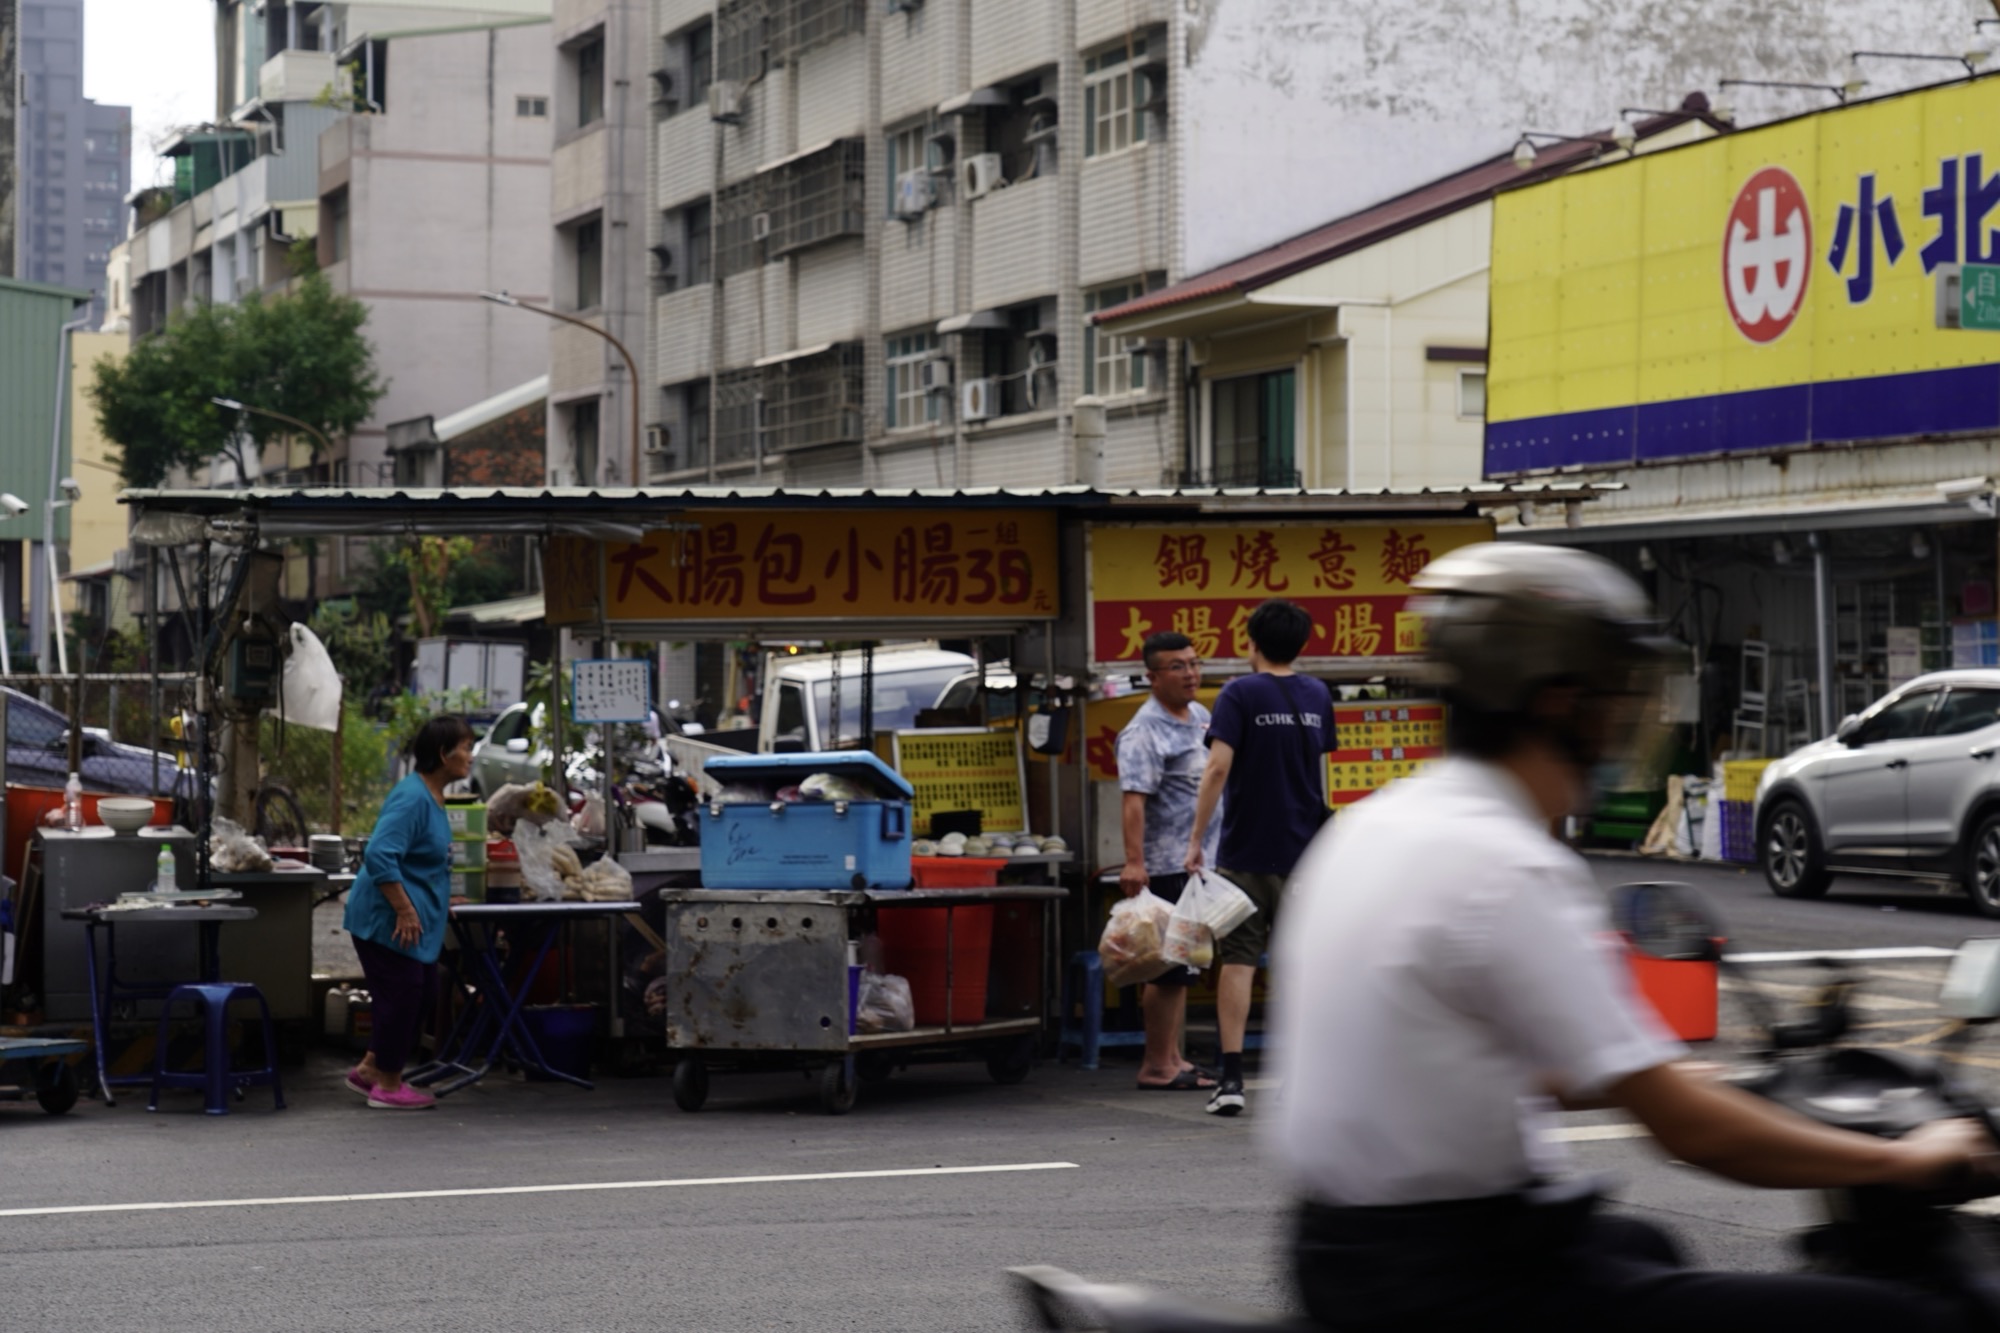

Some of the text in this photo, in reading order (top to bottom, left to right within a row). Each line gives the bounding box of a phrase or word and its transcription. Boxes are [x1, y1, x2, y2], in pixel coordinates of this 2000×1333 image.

[1827, 152, 2000, 305] 小北
[609, 522, 961, 608] 大腸包小腸
[1153, 528, 1431, 593] 鍋燒意麵
[1254, 712, 1296, 727] CUHK
